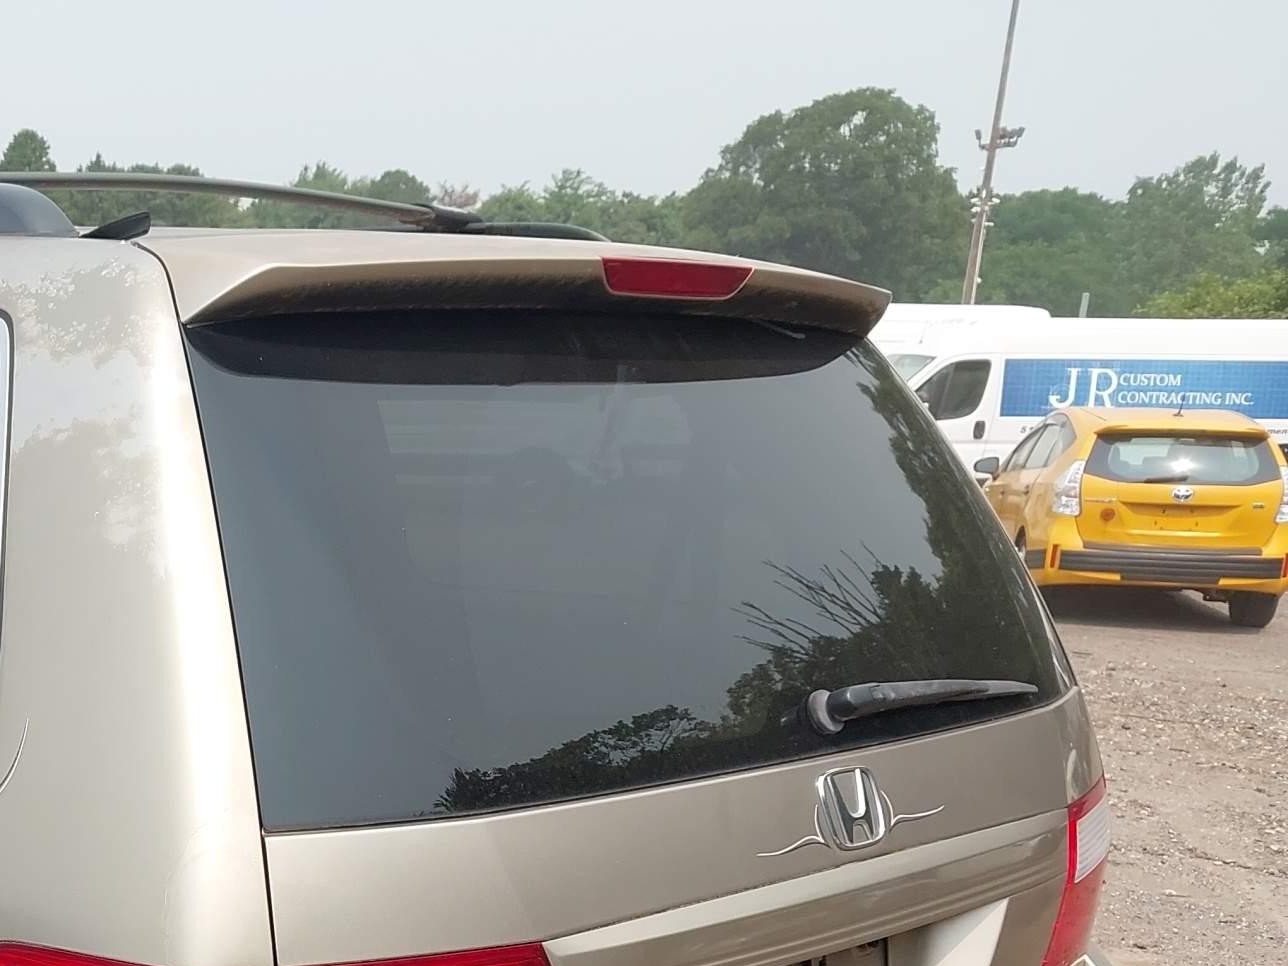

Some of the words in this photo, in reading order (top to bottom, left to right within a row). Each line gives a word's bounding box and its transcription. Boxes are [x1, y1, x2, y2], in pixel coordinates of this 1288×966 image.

[1119, 373, 1183, 387] CUSTOM
[1117, 390, 1221, 405] CONTRACTING
[1224, 391, 1255, 406] INC.
